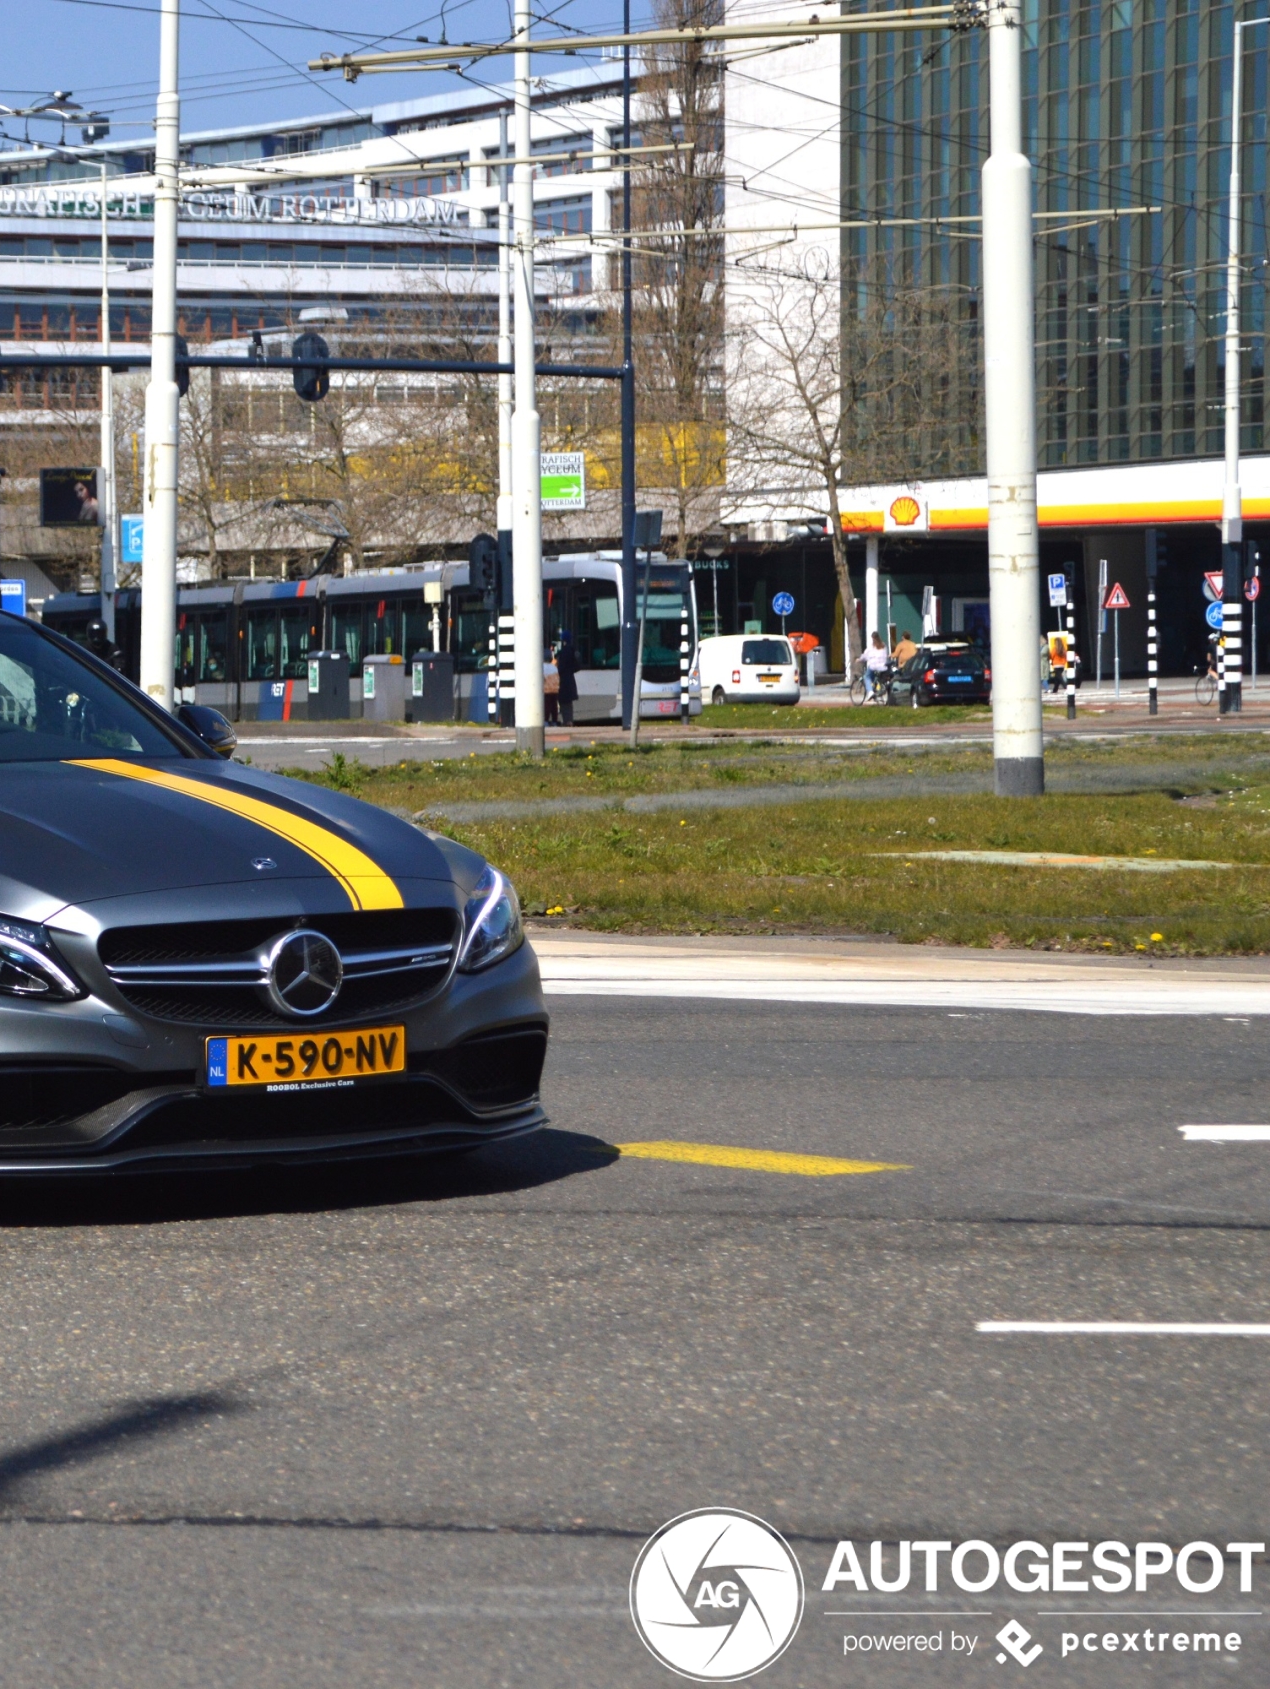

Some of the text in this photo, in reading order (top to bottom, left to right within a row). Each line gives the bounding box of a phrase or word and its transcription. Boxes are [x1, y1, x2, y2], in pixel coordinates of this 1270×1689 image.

[281, 195, 459, 223] ROTTERDAM
[541, 455, 581, 464] RAFISCH
[541, 464, 581, 474] YCEUM
[694, 560, 730, 569] BUCKS
[237, 1032, 398, 1079] K-590-NV
[210, 1066, 224, 1077] NL
[267, 1079, 354, 1092] ROOBOL Exclusive Cars
